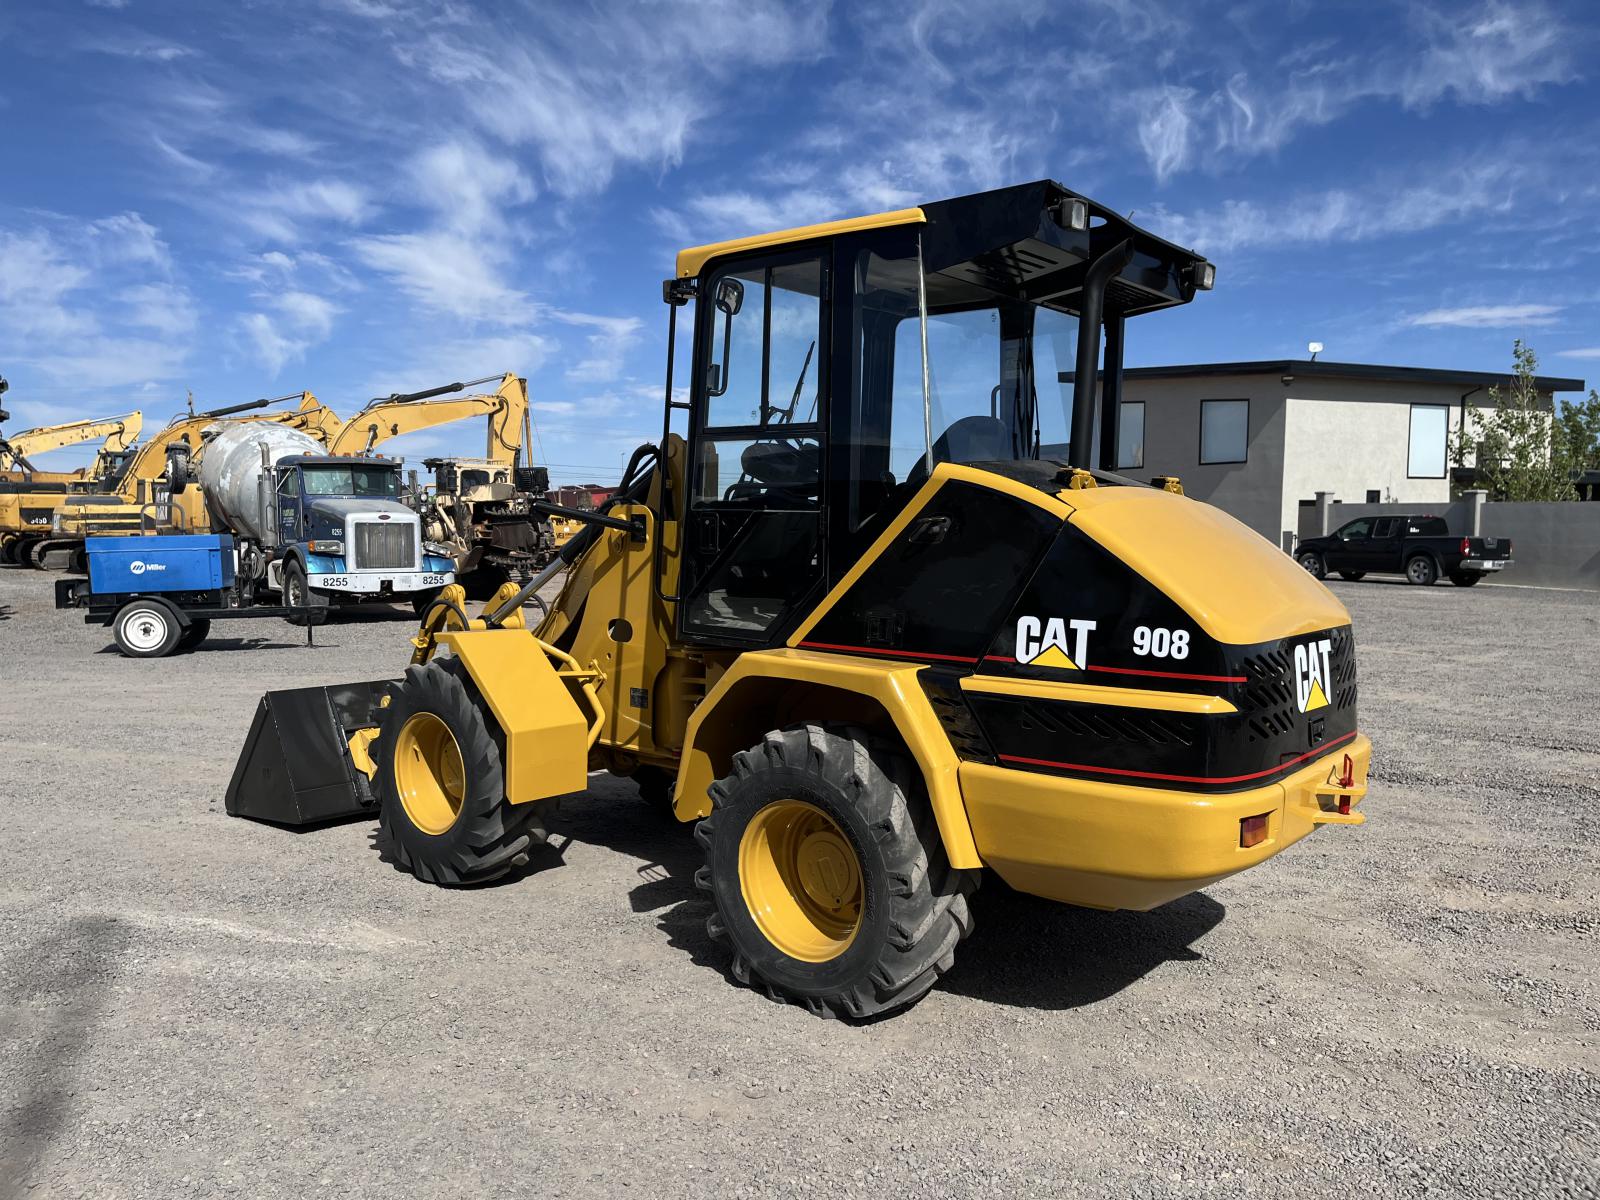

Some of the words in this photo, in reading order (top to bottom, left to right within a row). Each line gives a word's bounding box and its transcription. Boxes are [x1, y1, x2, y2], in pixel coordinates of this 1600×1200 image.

[331, 528, 343, 536] 8255
[146, 563, 167, 571] Miller
[322, 577, 348, 587] 8255
[422, 575, 445, 585] 8255
[1015, 615, 1097, 671] CAT
[1132, 625, 1190, 660] 908
[1294, 639, 1332, 714] CAT
